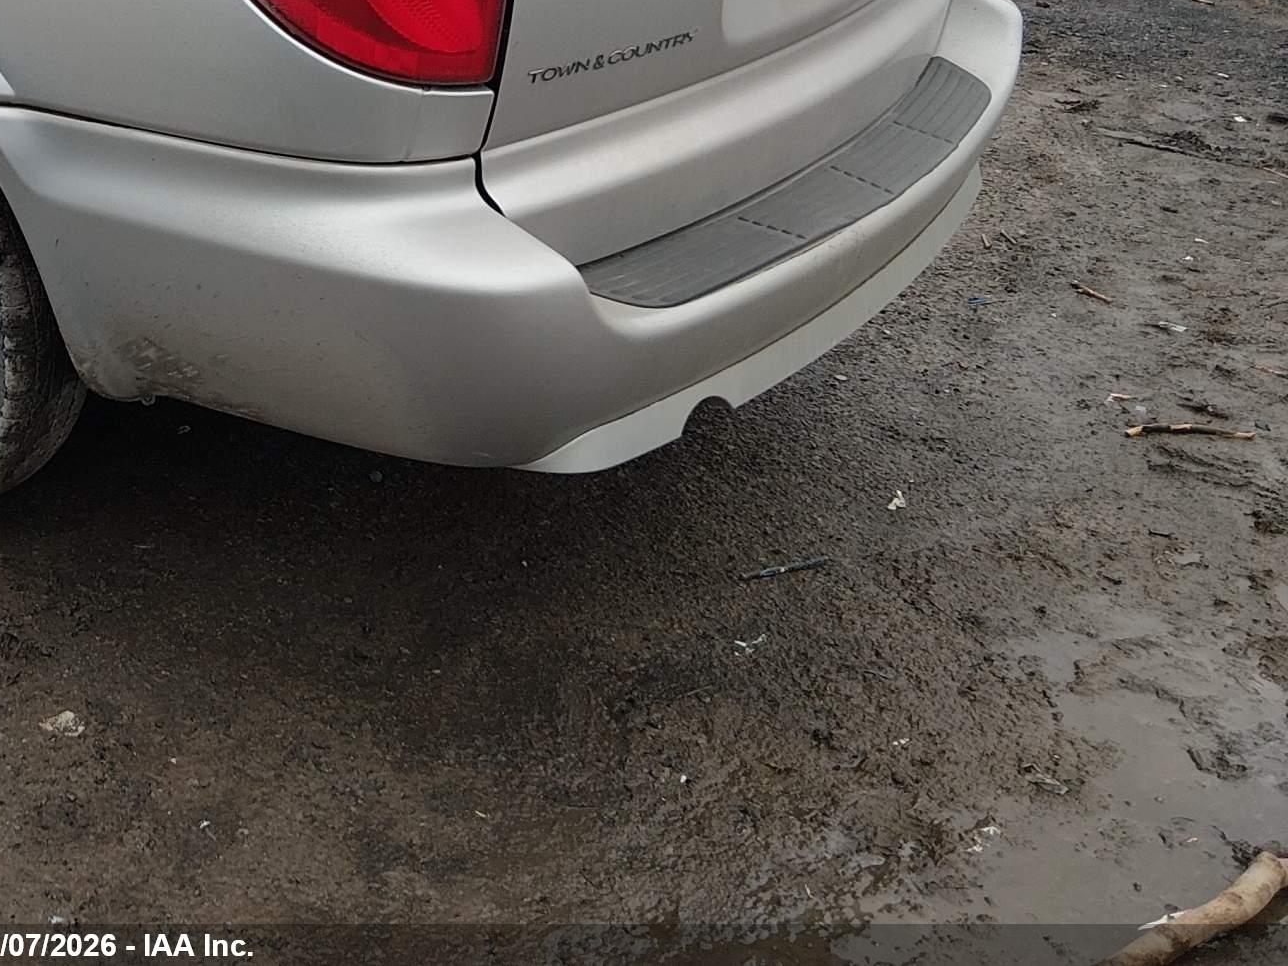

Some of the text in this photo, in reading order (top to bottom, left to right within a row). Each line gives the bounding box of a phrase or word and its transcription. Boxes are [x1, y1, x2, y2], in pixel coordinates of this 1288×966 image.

[527, 28, 699, 84] TOWN & COUNTRY
